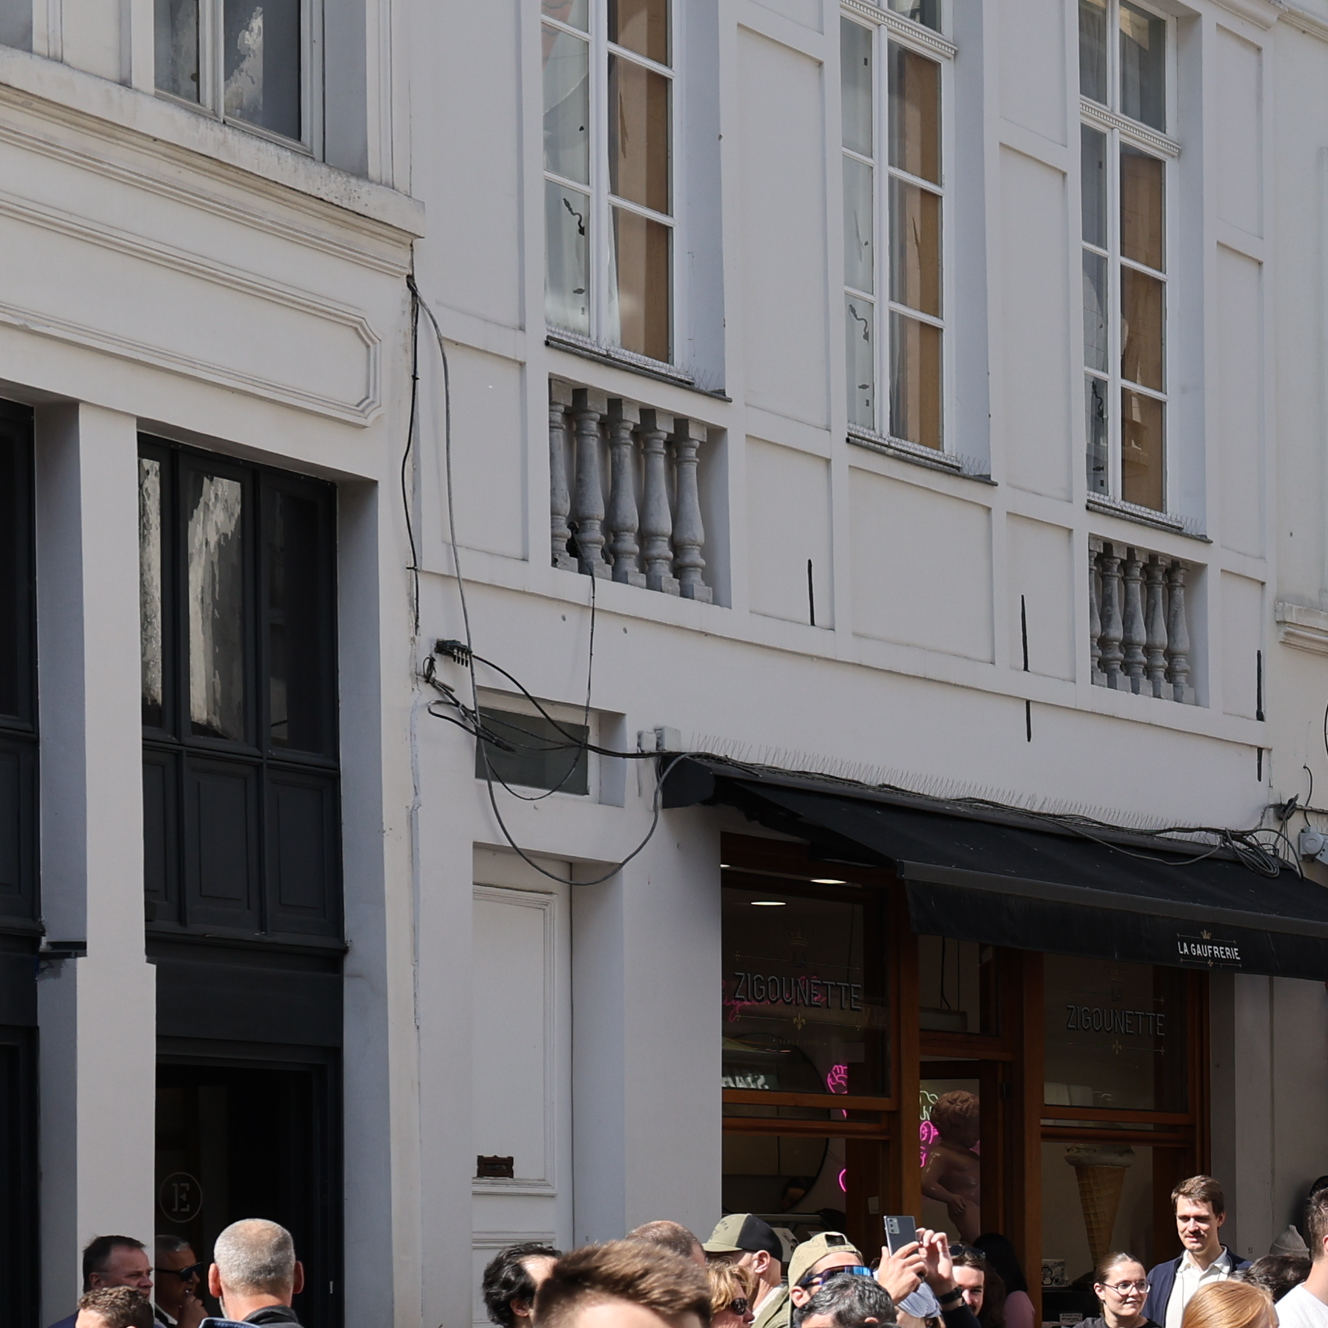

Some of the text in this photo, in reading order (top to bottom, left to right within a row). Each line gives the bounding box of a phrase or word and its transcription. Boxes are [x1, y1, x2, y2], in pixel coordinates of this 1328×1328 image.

[1177, 941, 1241, 960] LA GAUFRERIE
[734, 972, 862, 1011] ZIGOUNETTE
[1066, 1004, 1165, 1036] ZIGOUNETTE
